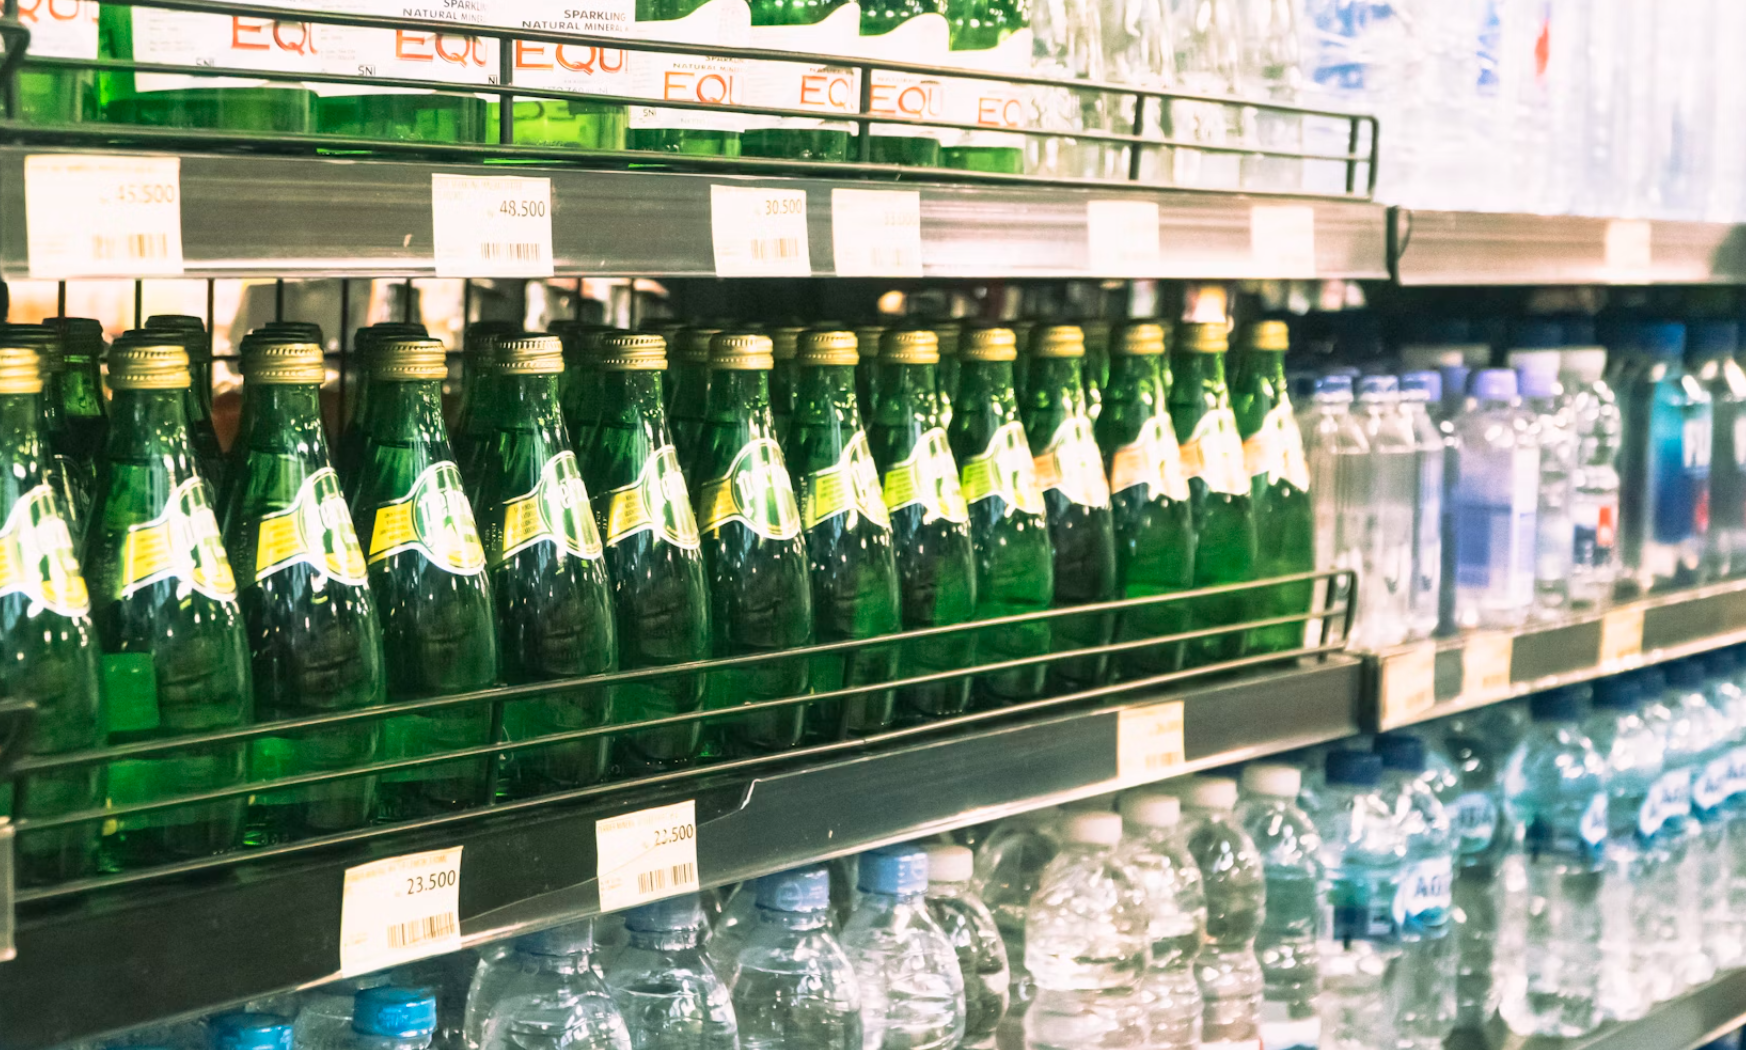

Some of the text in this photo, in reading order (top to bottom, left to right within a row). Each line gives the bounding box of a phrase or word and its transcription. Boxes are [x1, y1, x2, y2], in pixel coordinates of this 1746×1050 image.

[402, 8, 457, 20] NATURAL
[562, 9, 626, 22] SPARKLING
[521, 20, 580, 31] NATURAL
[499, 199, 546, 218] 48.500
[765, 198, 803, 216] 30.500
[406, 869, 456, 896] 23.500
